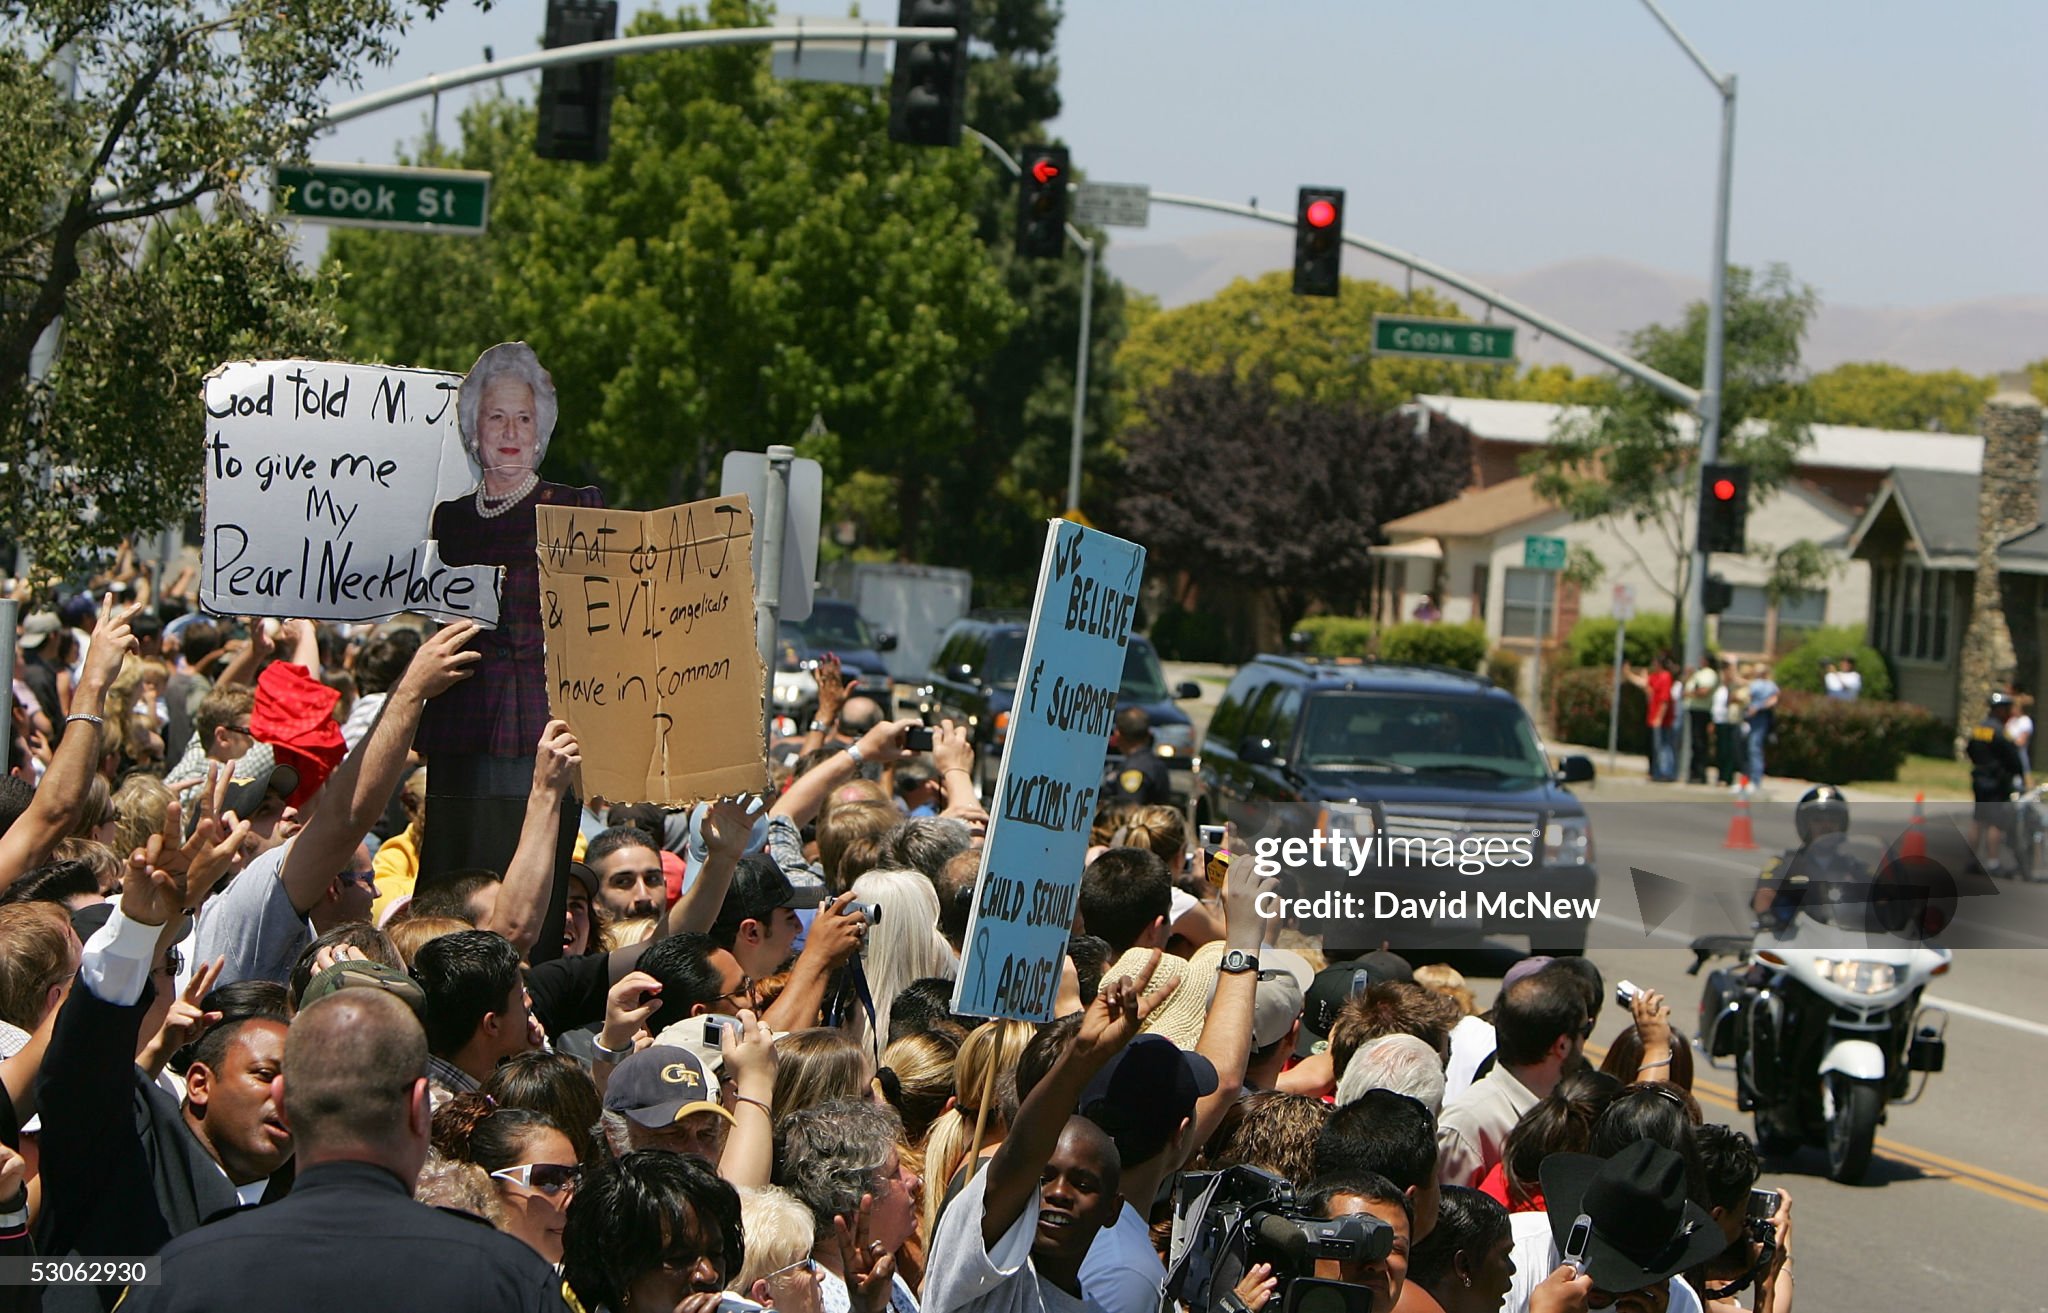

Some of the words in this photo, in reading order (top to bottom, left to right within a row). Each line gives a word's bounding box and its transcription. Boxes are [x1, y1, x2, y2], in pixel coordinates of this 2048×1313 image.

[303, 180, 396, 215] Cook
[416, 187, 455, 217] St
[1393, 326, 1456, 350] Cook
[1468, 331, 1495, 354] St
[286, 368, 349, 420] told
[208, 430, 243, 479] to
[255, 453, 317, 492] give
[330, 453, 397, 488] me
[306, 485, 358, 540] My
[213, 523, 310, 601] Pearl
[316, 540, 475, 610] Necklace
[545, 511, 618, 568] What
[629, 519, 658, 579] do
[1055, 526, 1084, 583] WE
[545, 590, 563, 629] &
[1065, 574, 1135, 647] BELIEVE
[557, 653, 607, 706] have
[617, 672, 647, 702] in
[1046, 676, 1119, 738] SUPPORT
[652, 713, 673, 776] ?
[1005, 772, 1071, 830] VICTIMS
[1071, 787, 1095, 832] OF
[978, 871, 1025, 924] CHILD
[1026, 878, 1076, 930] SEXUAL
[992, 941, 1066, 1022] ABUSE!
[661, 1063, 700, 1088] GT
